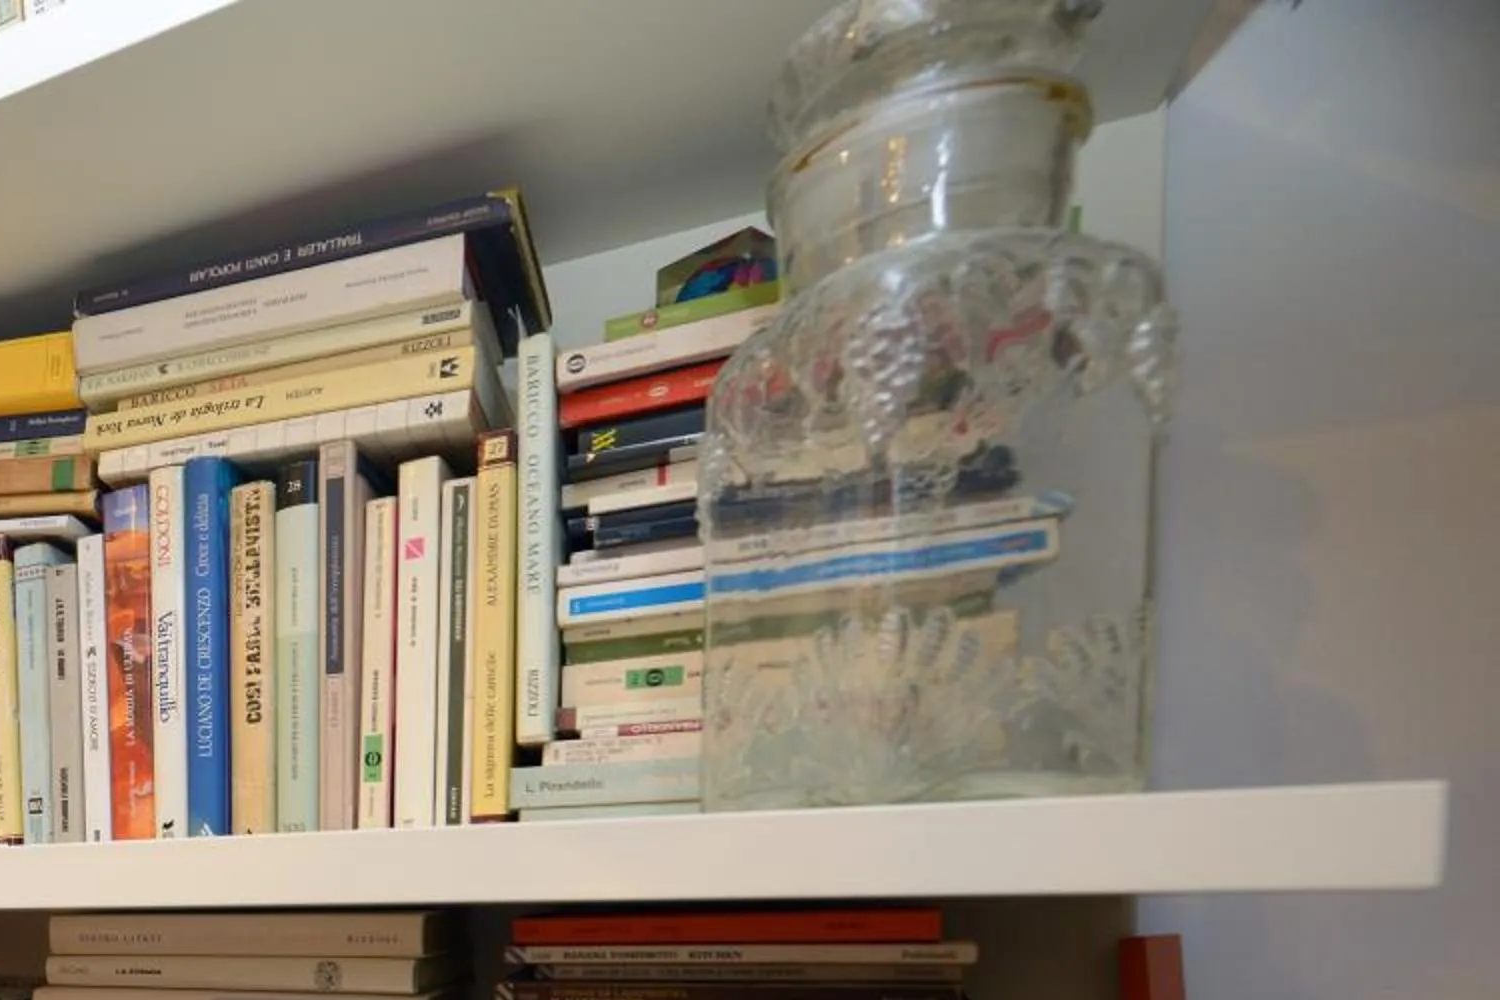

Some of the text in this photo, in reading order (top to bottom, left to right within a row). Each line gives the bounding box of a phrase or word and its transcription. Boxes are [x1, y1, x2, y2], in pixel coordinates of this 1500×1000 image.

[245, 394, 265, 412] La
[196, 588, 212, 669] CRESCENZO
[197, 672, 212, 690] DE
[197, 694, 212, 757] LUCIANO
